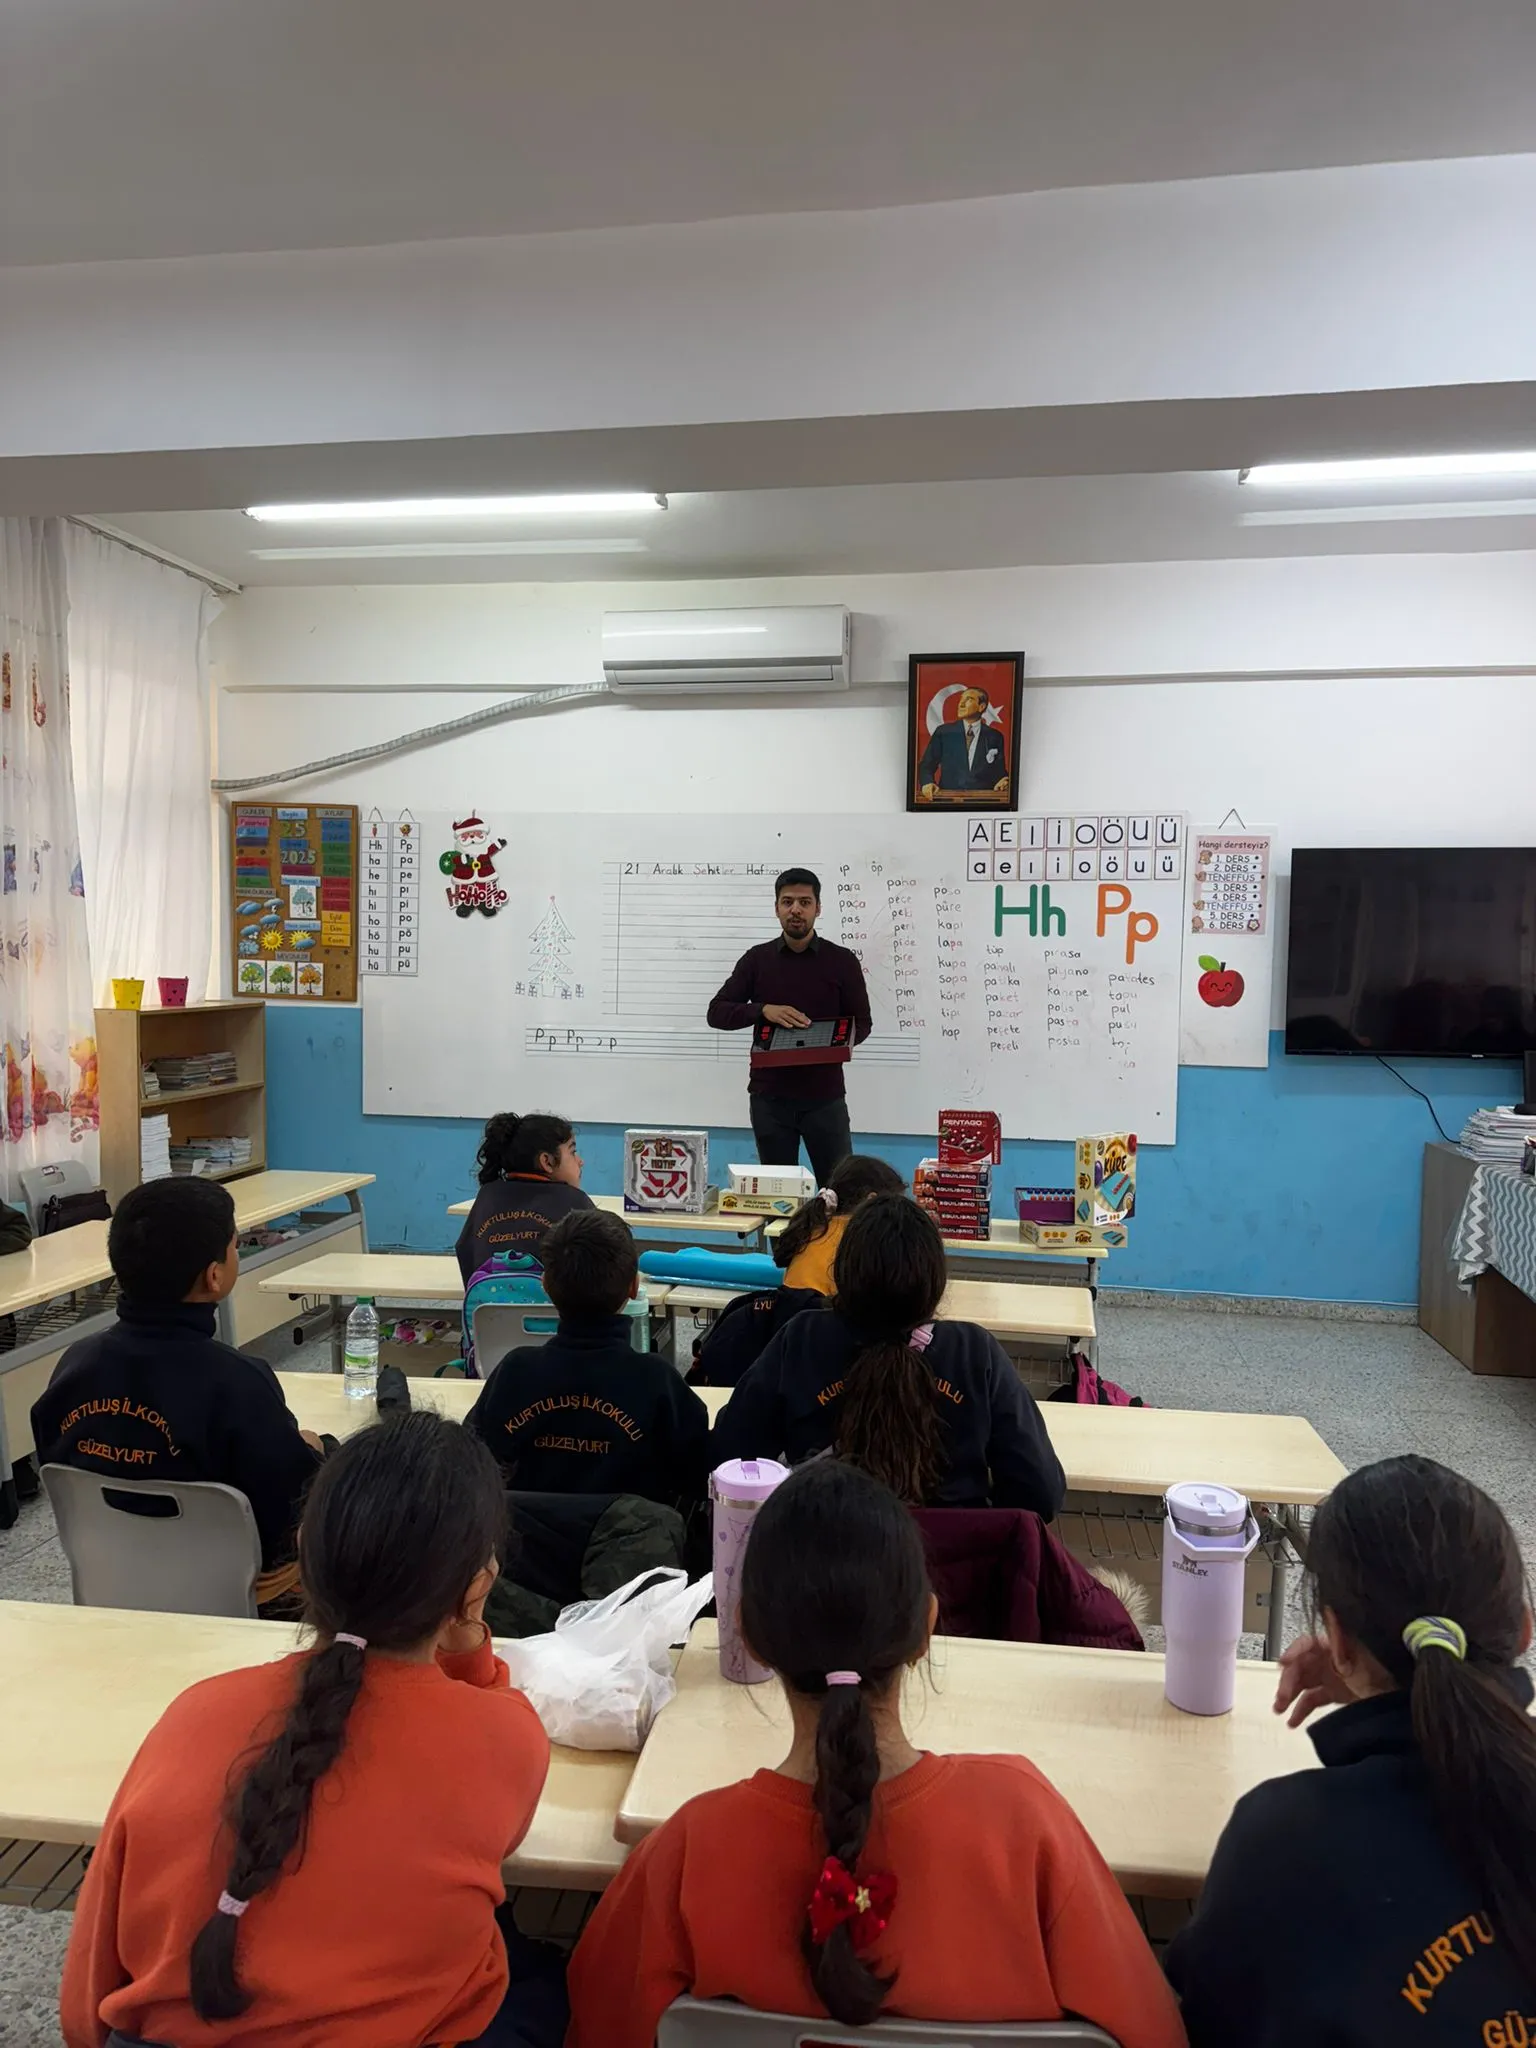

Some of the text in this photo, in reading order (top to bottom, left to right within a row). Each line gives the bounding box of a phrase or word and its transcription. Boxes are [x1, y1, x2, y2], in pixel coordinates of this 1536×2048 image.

[971, 822, 989, 843] A
[1000, 822, 1013, 843] E
[1102, 819, 1124, 844] Ö
[369, 840, 382, 850] Hh
[400, 839, 413, 853] Pp
[1198, 841, 1222, 850] Hangi
[281, 849, 316, 865] 2025
[369, 854, 380, 865] ha
[400, 856, 413, 868] pa
[1226, 855, 1250, 863] DERS
[624, 863, 639, 875] 21
[974, 861, 986, 875] a
[999, 861, 1012, 874] e
[1106, 856, 1118, 873] ö
[1134, 860, 1145, 872] u
[1162, 856, 1173, 872] ü
[1225, 865, 1249, 873] DERS
[369, 869, 380, 880] he
[400, 872, 412, 882] pe
[1223, 883, 1248, 892] DERS
[1223, 893, 1247, 901] DERS
[994, 883, 1066, 937] Hh
[1220, 912, 1245, 920] DERS
[368, 914, 380, 925] ho
[399, 915, 412, 926] po
[1096, 883, 1159, 965] Pp
[1220, 921, 1244, 929] DERS
[368, 929, 380, 940] hö
[399, 929, 412, 941] pö
[368, 944, 379, 955] hu
[938, 936, 963, 951] lapa
[398, 945, 410, 957] pu
[367, 959, 379, 970] hü
[398, 959, 410, 971] pü
[937, 956, 966, 971] kupa
[896, 988, 915, 1001] pim
[1111, 1004, 1131, 1018] pul
[943, 1119, 983, 1127] PENTAGO
[488, 1231, 540, 1244] GÜZELYURT
[60, 1398, 121, 1434] KURTULUŞ
[504, 1392, 644, 1441] KURTULUŞ İLKOKULU
[534, 1433, 611, 1454] GÜZELYURT
[77, 1438, 158, 1464] GÜZELYURT
[1172, 1560, 1209, 1577] STANLEY
